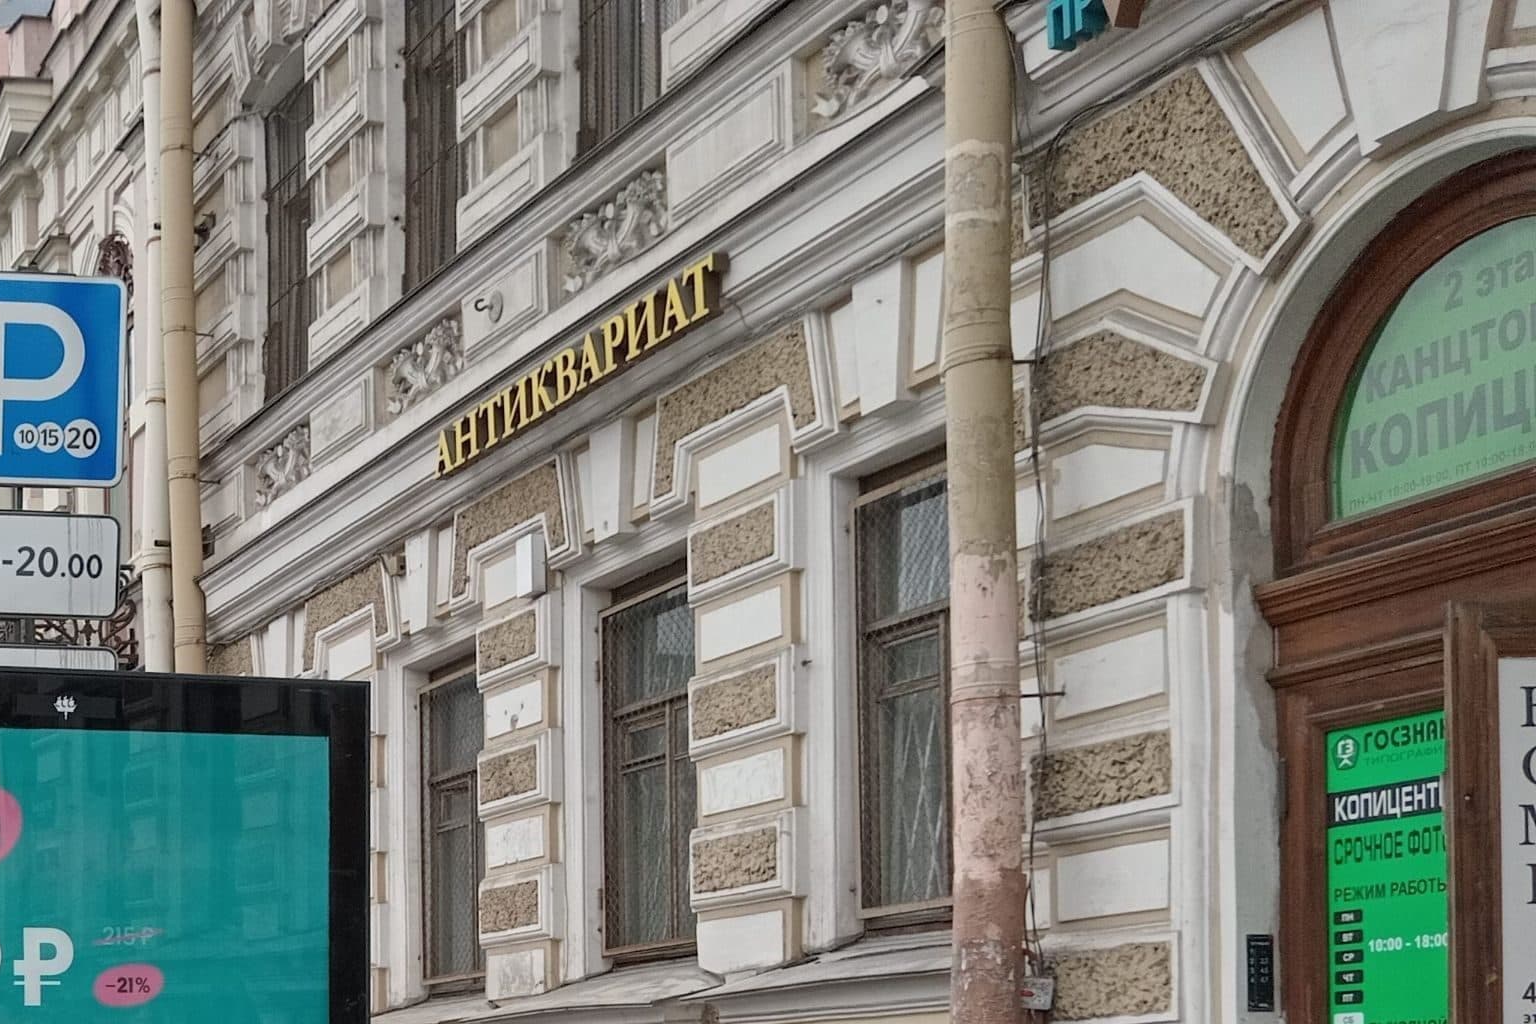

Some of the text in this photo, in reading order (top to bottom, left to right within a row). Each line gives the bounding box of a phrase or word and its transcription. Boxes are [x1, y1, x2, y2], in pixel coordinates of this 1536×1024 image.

[1444, 249, 1536, 312] 2 эта
[433, 252, 715, 480] АНТИКВАРИАТ
[1365, 302, 1536, 404] КАНЦТО
[19, 428, 97, 450] 10 15 20
[1351, 364, 1536, 479] КОПИЦ
[1364, 744, 1443, 766] ТИПОГРАФИ
[1334, 780, 1443, 822] КОПИЦЕНТ
[1334, 825, 1446, 865] СРОЧНОЕ ФОТ
[1334, 884, 1385, 902] РЕЖИМ
